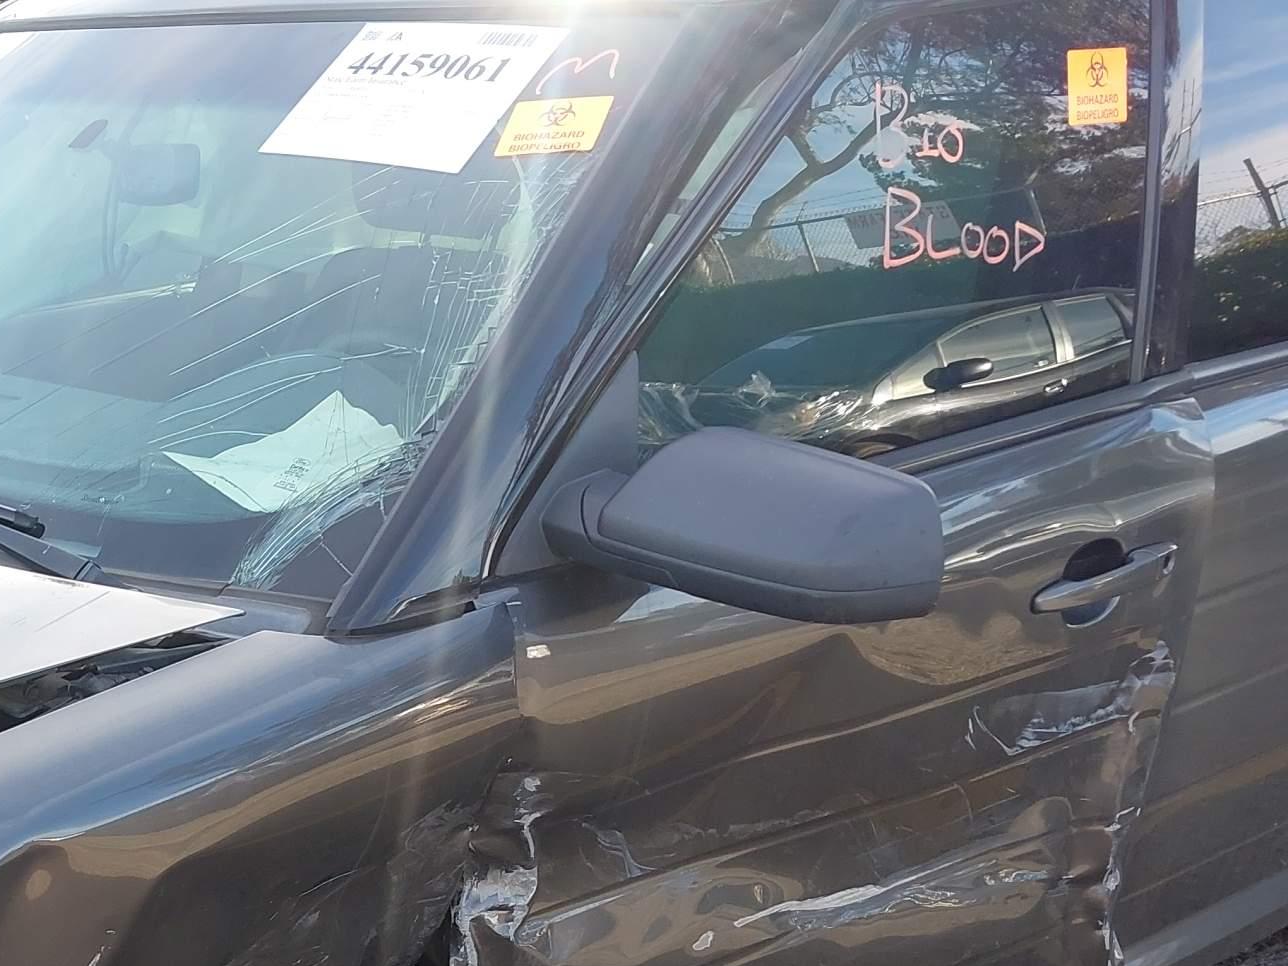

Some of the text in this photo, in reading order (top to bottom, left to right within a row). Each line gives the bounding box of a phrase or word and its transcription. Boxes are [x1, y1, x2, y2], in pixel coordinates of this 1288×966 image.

[347, 52, 512, 83] 44159061
[1076, 94, 1119, 106] BIOHAZARD
[1076, 108, 1119, 121] BIOPELIGRO
[513, 130, 585, 142] BIOHAZARD
[883, 186, 1047, 272] BLOOD
